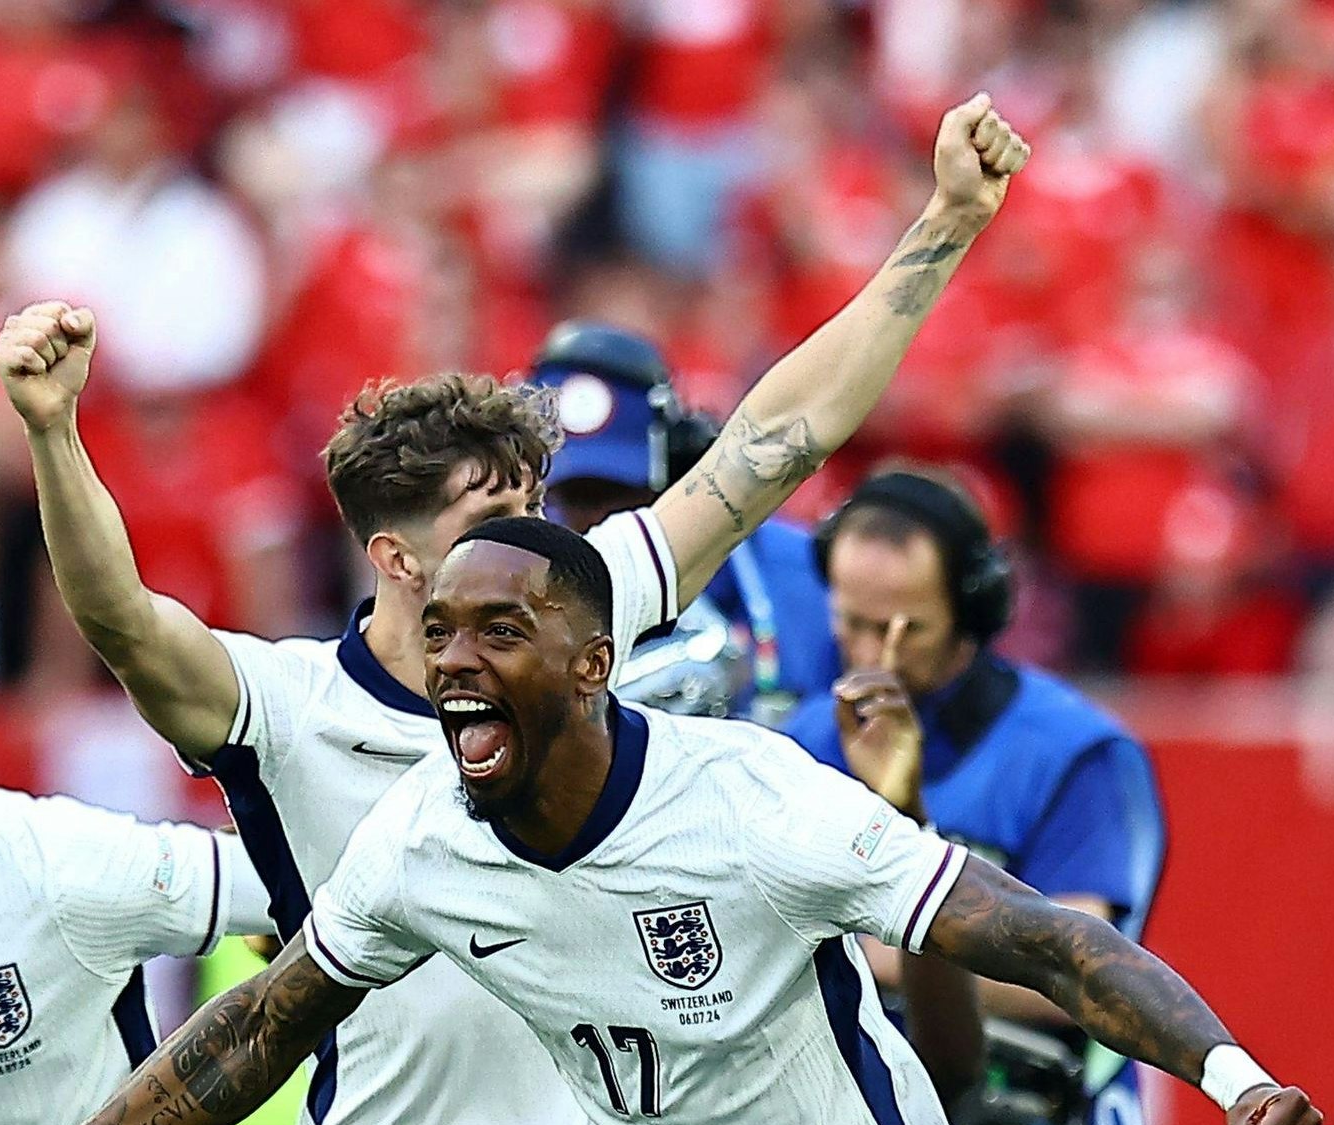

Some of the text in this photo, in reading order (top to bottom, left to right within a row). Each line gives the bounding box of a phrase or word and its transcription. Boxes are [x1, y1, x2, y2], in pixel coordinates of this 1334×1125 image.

[660, 990, 734, 1011] SWITZERLAND
[679, 1009, 721, 1026] 06.07.24
[570, 1023, 662, 1118] 17
